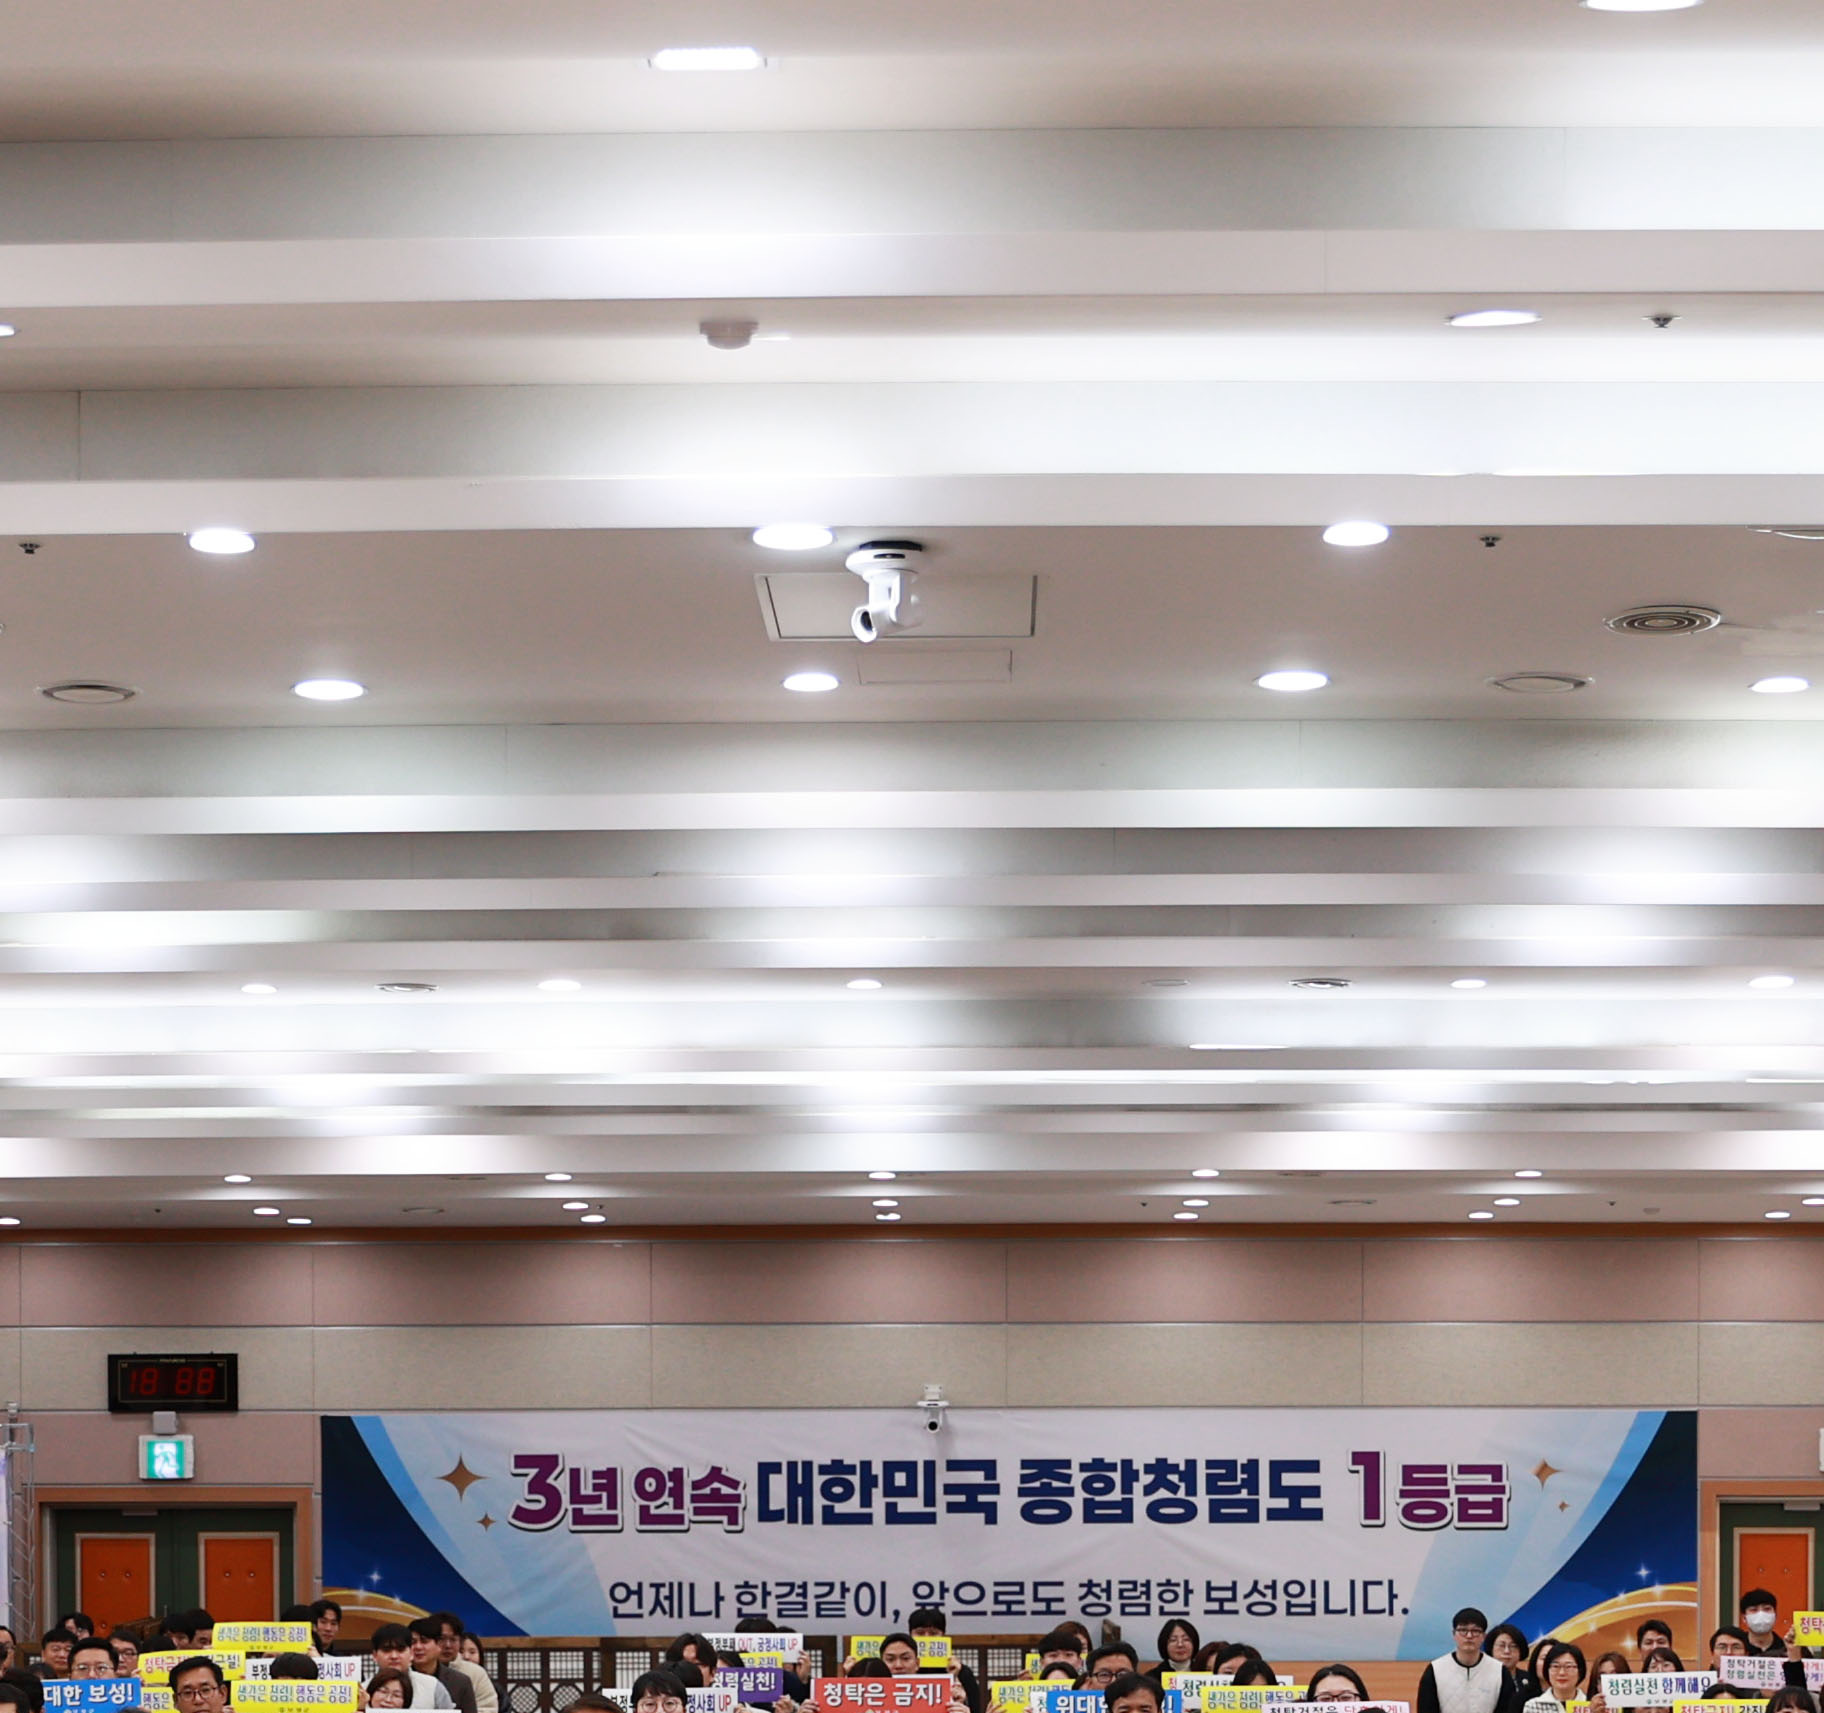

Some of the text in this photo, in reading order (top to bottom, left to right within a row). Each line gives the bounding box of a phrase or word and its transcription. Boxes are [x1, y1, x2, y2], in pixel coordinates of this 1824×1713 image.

[509, 1447, 1510, 1531] 3년 연속 대한민국 종합청렴도 1등급
[608, 1577, 1410, 1623] 언제나 한결같이, 앞으로도 청렴한 보성입니다.
[823, 1681, 942, 1707] 청탁은 금지!
